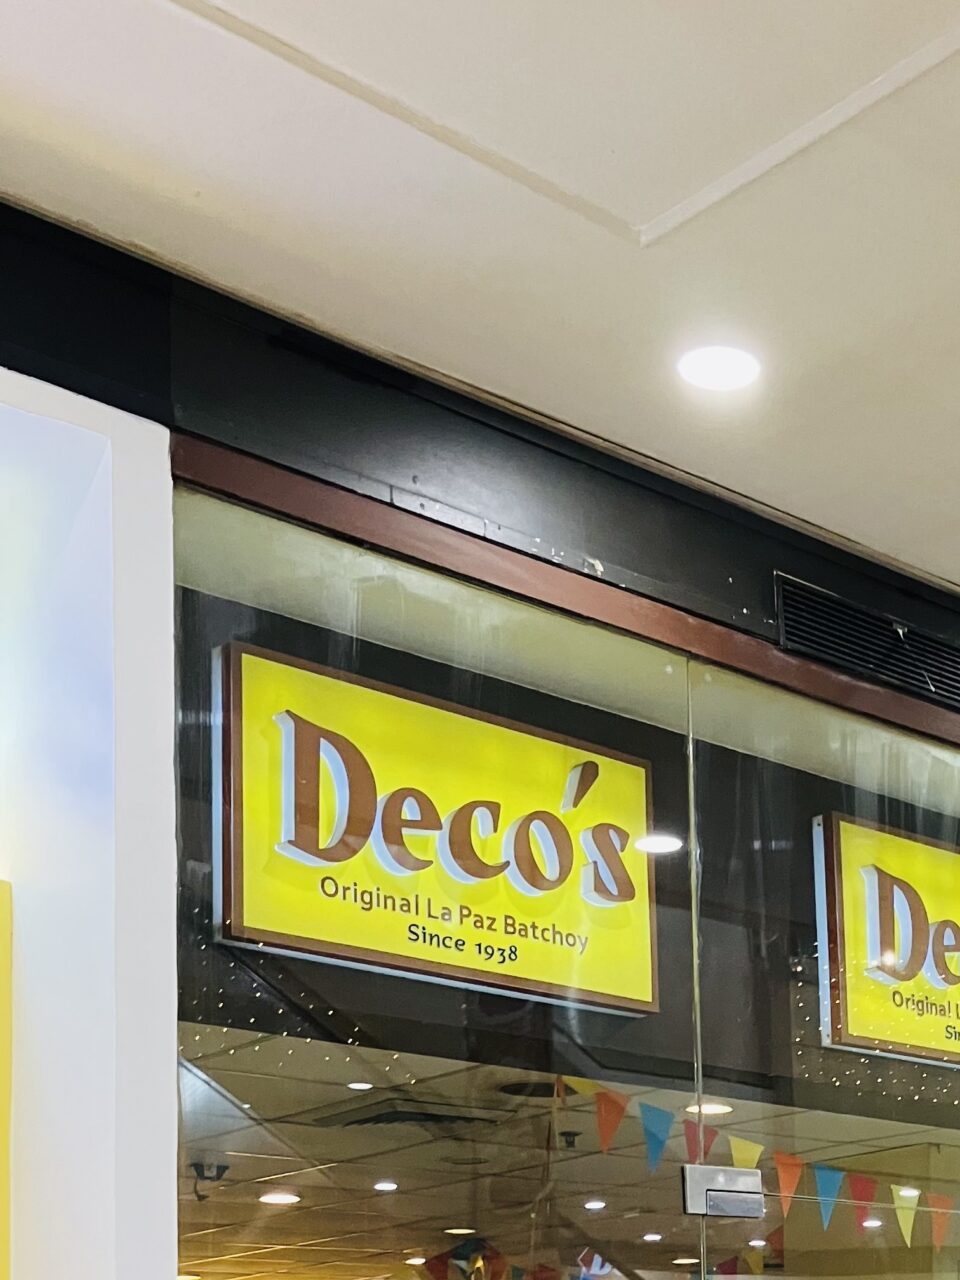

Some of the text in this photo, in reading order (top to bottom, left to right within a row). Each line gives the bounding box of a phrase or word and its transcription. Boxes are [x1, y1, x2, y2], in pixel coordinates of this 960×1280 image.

[273, 709, 637, 907] Deco's
[320, 876, 589, 955] Original La Paz Batchoy
[407, 923, 518, 964] Since 1938
[892, 990, 951, 1017] Original
